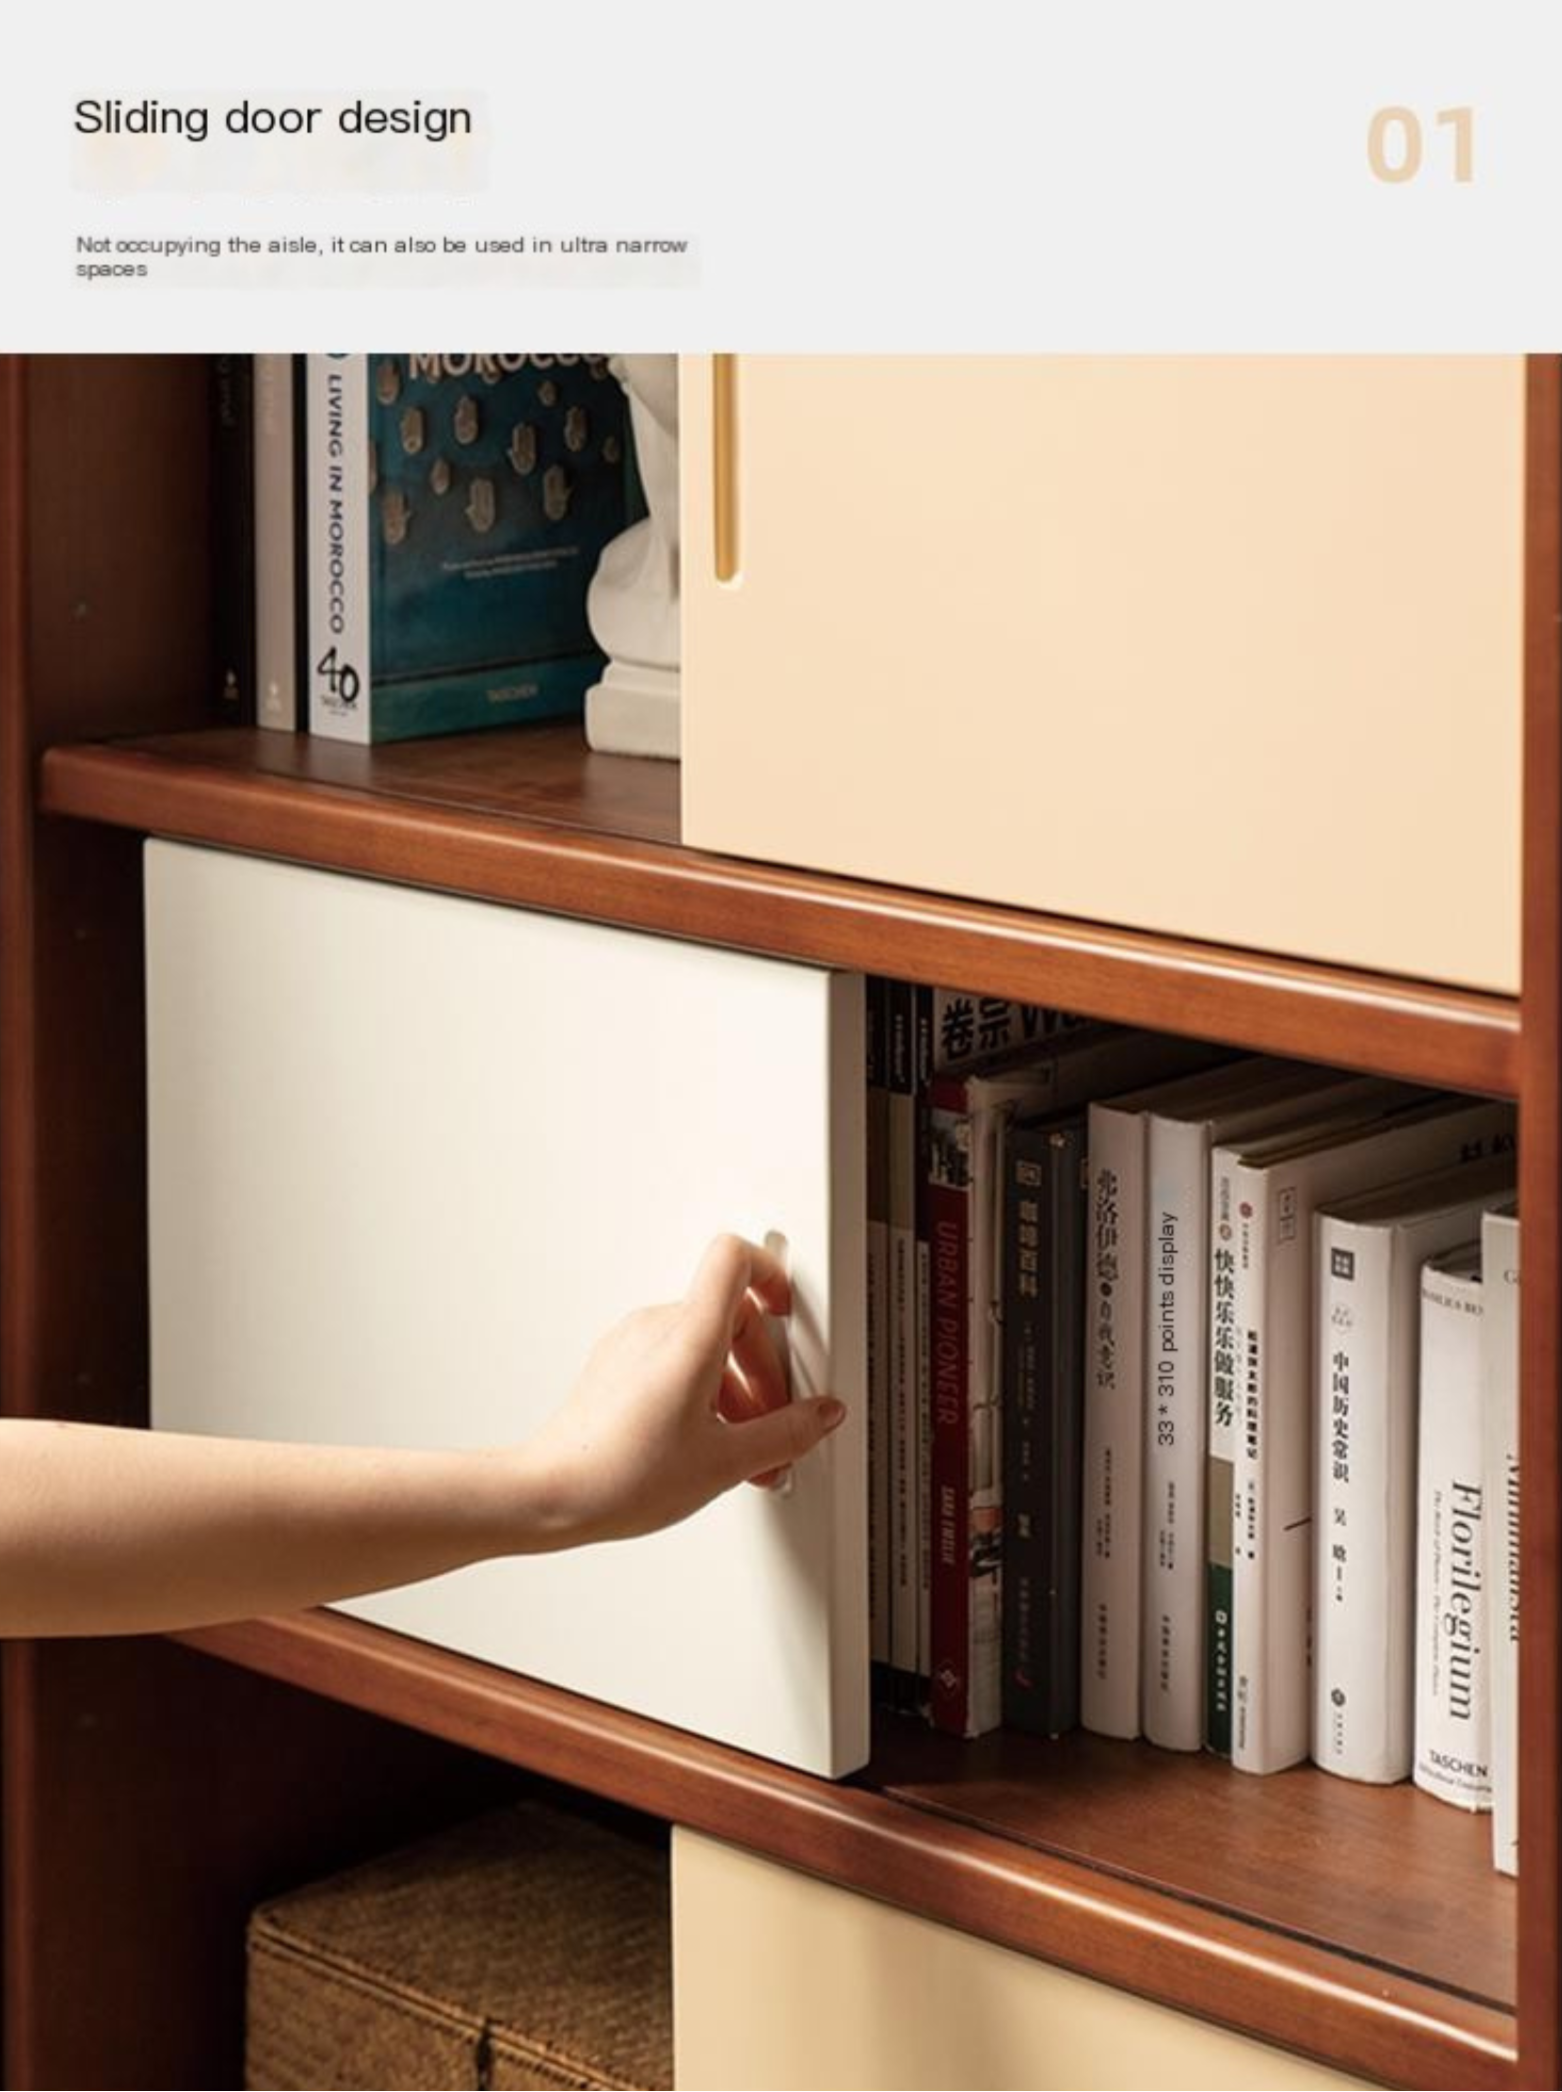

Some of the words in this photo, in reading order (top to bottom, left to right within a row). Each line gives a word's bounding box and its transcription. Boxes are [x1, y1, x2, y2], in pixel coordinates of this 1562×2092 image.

[409, 353, 608, 379] MORO
[328, 373, 343, 458] LIVING
[328, 464, 343, 493] IN
[328, 499, 345, 635] MOROCCO
[316, 645, 361, 703] 40
[936, 1221, 959, 1306] URBAN
[934, 1317, 959, 1425] PIONEER
[1214, 1248, 1235, 1427] 快快乐乐做服务
[1332, 1352, 1349, 1483] 中国历史常识
[1444, 1482, 1484, 1722] Florilegium
[1428, 1749, 1489, 1778] TASCHEN
